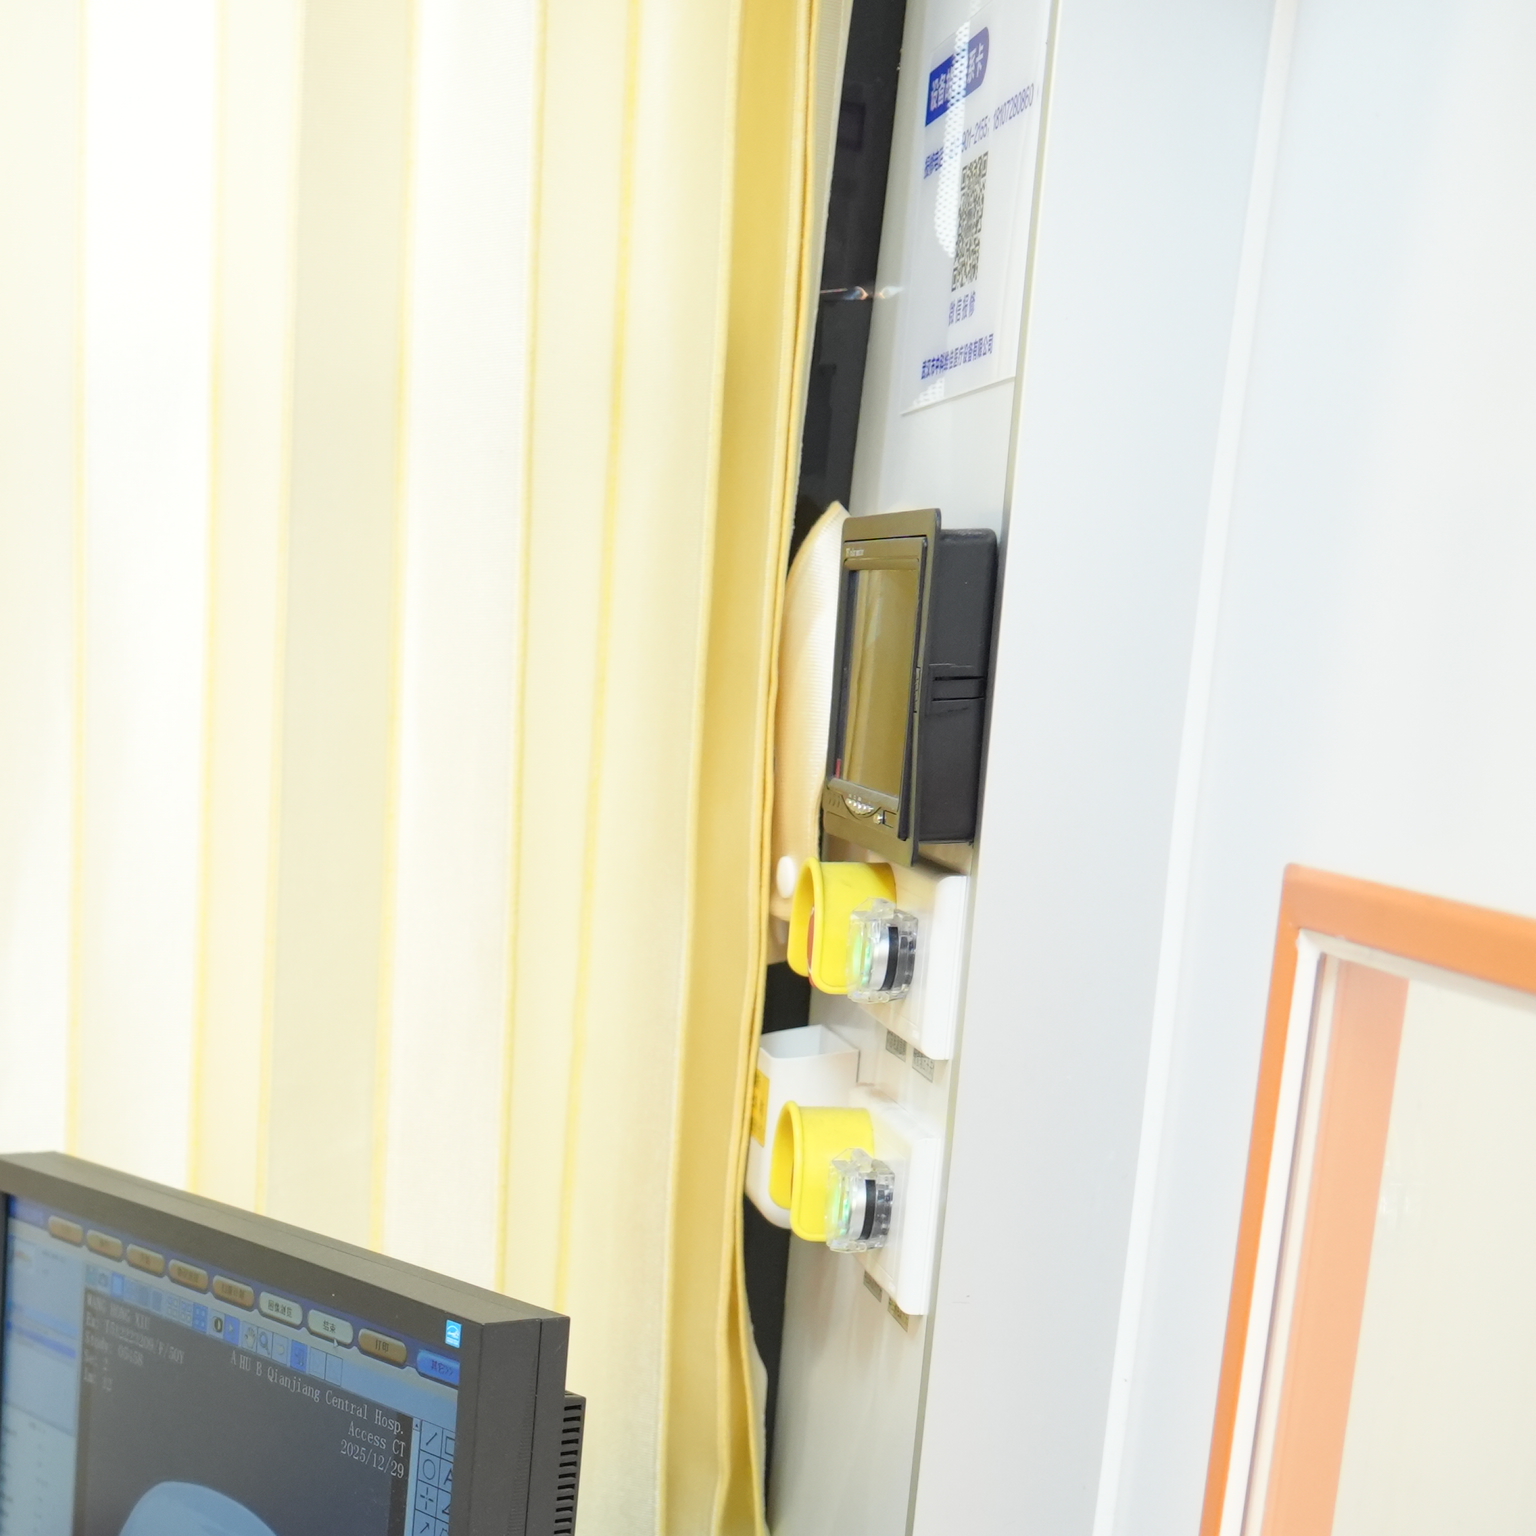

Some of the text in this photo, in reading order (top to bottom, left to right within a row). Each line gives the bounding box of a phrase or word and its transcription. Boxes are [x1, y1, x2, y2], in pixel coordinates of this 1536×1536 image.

[320, 1320, 338, 1335] 结束
[375, 1339, 389, 1352] 打印
[267, 1365, 322, 1403] Qianjiang
[325, 1383, 369, 1420] Central
[373, 1401, 406, 1436] Hosp.
[347, 1420, 407, 1459] Access CT
[340, 1440, 406, 1479] 2025/12/29
